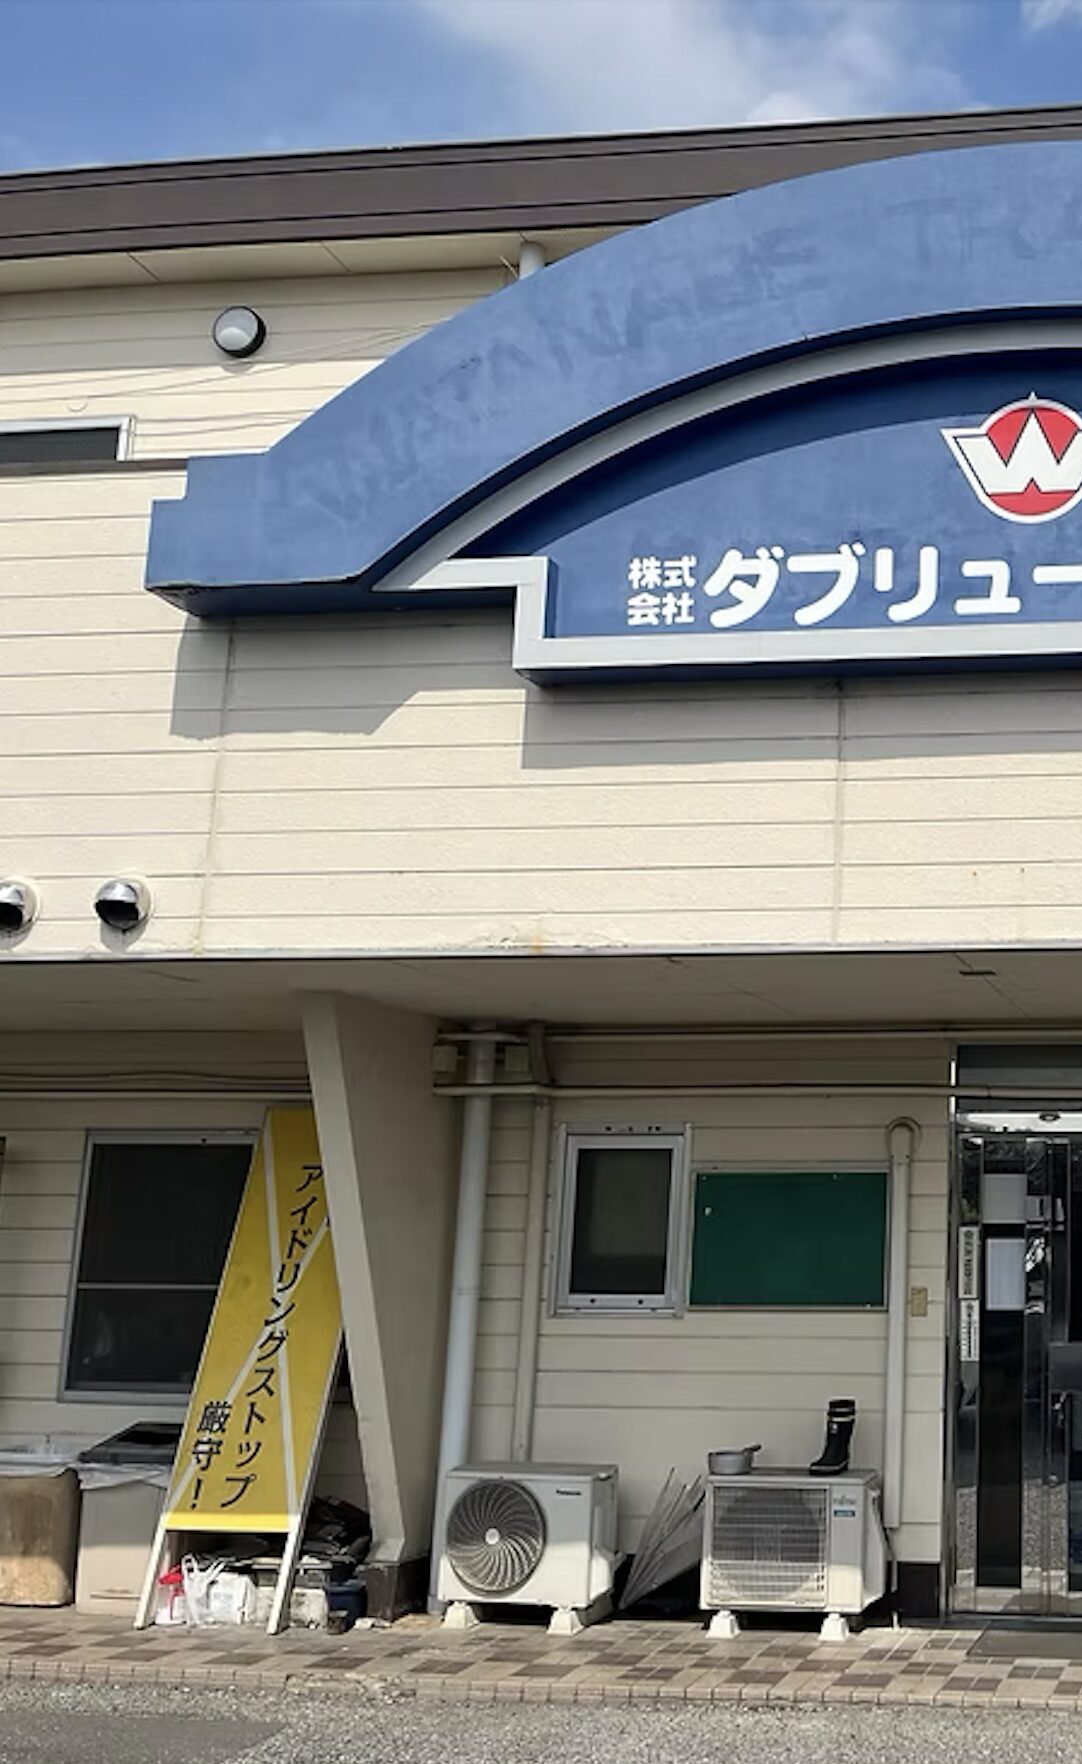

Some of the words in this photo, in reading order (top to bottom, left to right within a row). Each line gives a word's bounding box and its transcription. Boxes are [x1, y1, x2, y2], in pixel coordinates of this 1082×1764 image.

[628, 555, 697, 589] 株式
[627, 592, 695, 625] 会社
[220, 1164, 324, 1509] アイドリングストップ
